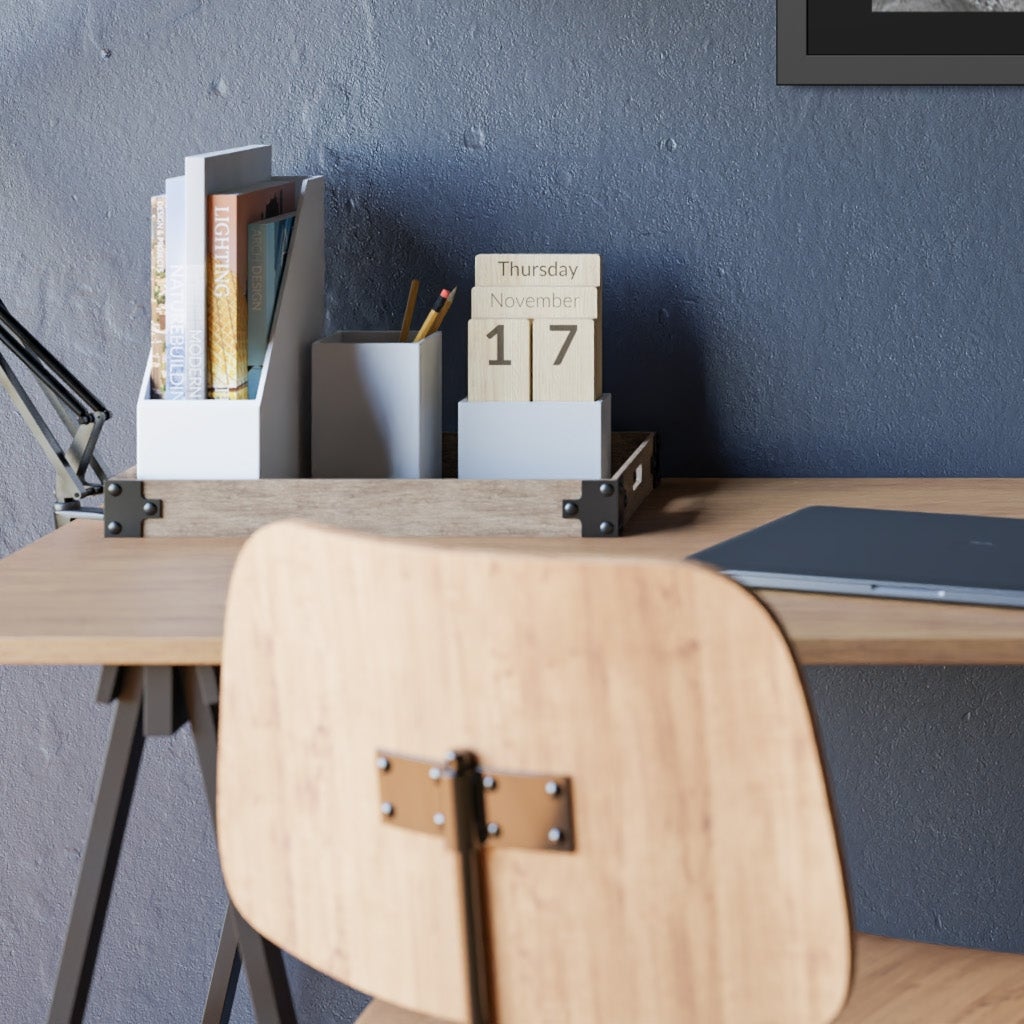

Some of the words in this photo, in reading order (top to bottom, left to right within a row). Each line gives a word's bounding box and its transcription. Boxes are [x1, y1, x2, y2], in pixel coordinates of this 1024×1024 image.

[214, 206, 230, 298] LIGHTING
[498, 261, 579, 280] Thursday
[252, 265, 262, 311] DESIGN
[490, 292, 580, 309] November
[189, 329, 203, 398] MODERN
